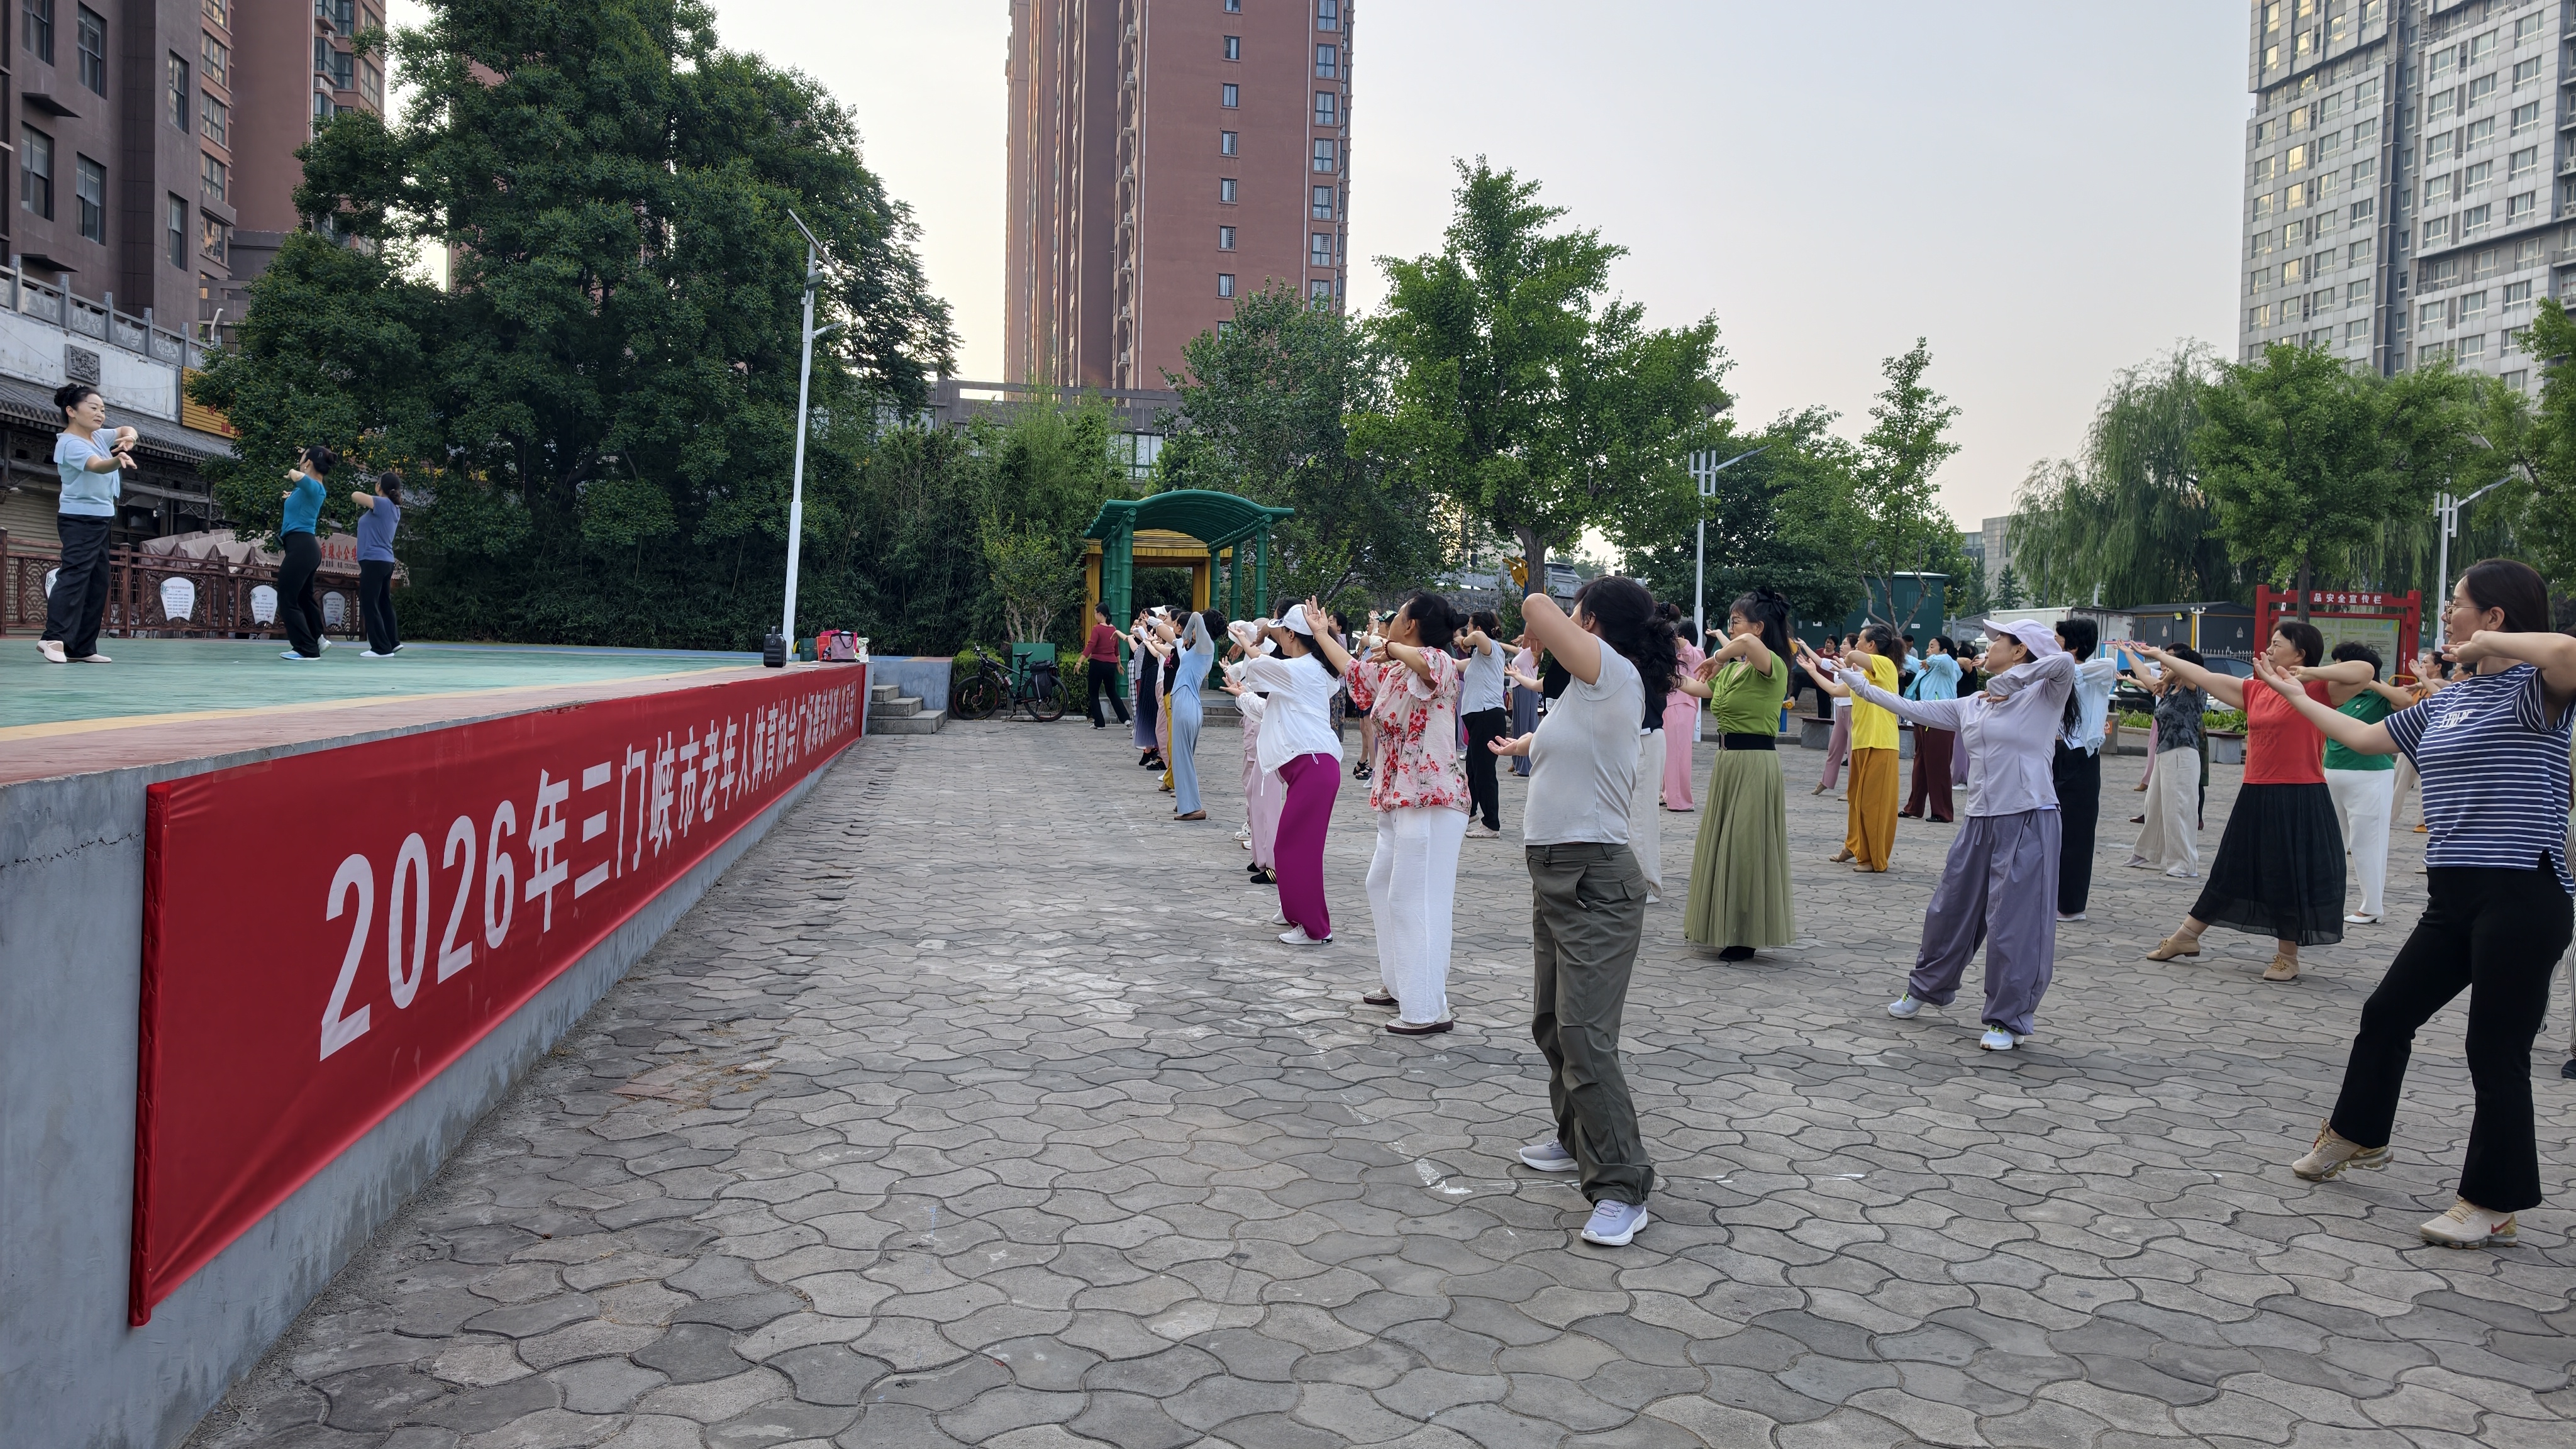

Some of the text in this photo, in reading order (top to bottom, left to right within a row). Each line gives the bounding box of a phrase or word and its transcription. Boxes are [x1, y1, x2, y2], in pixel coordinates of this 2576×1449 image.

[2314, 592, 2382, 604] 品安全宣传栏
